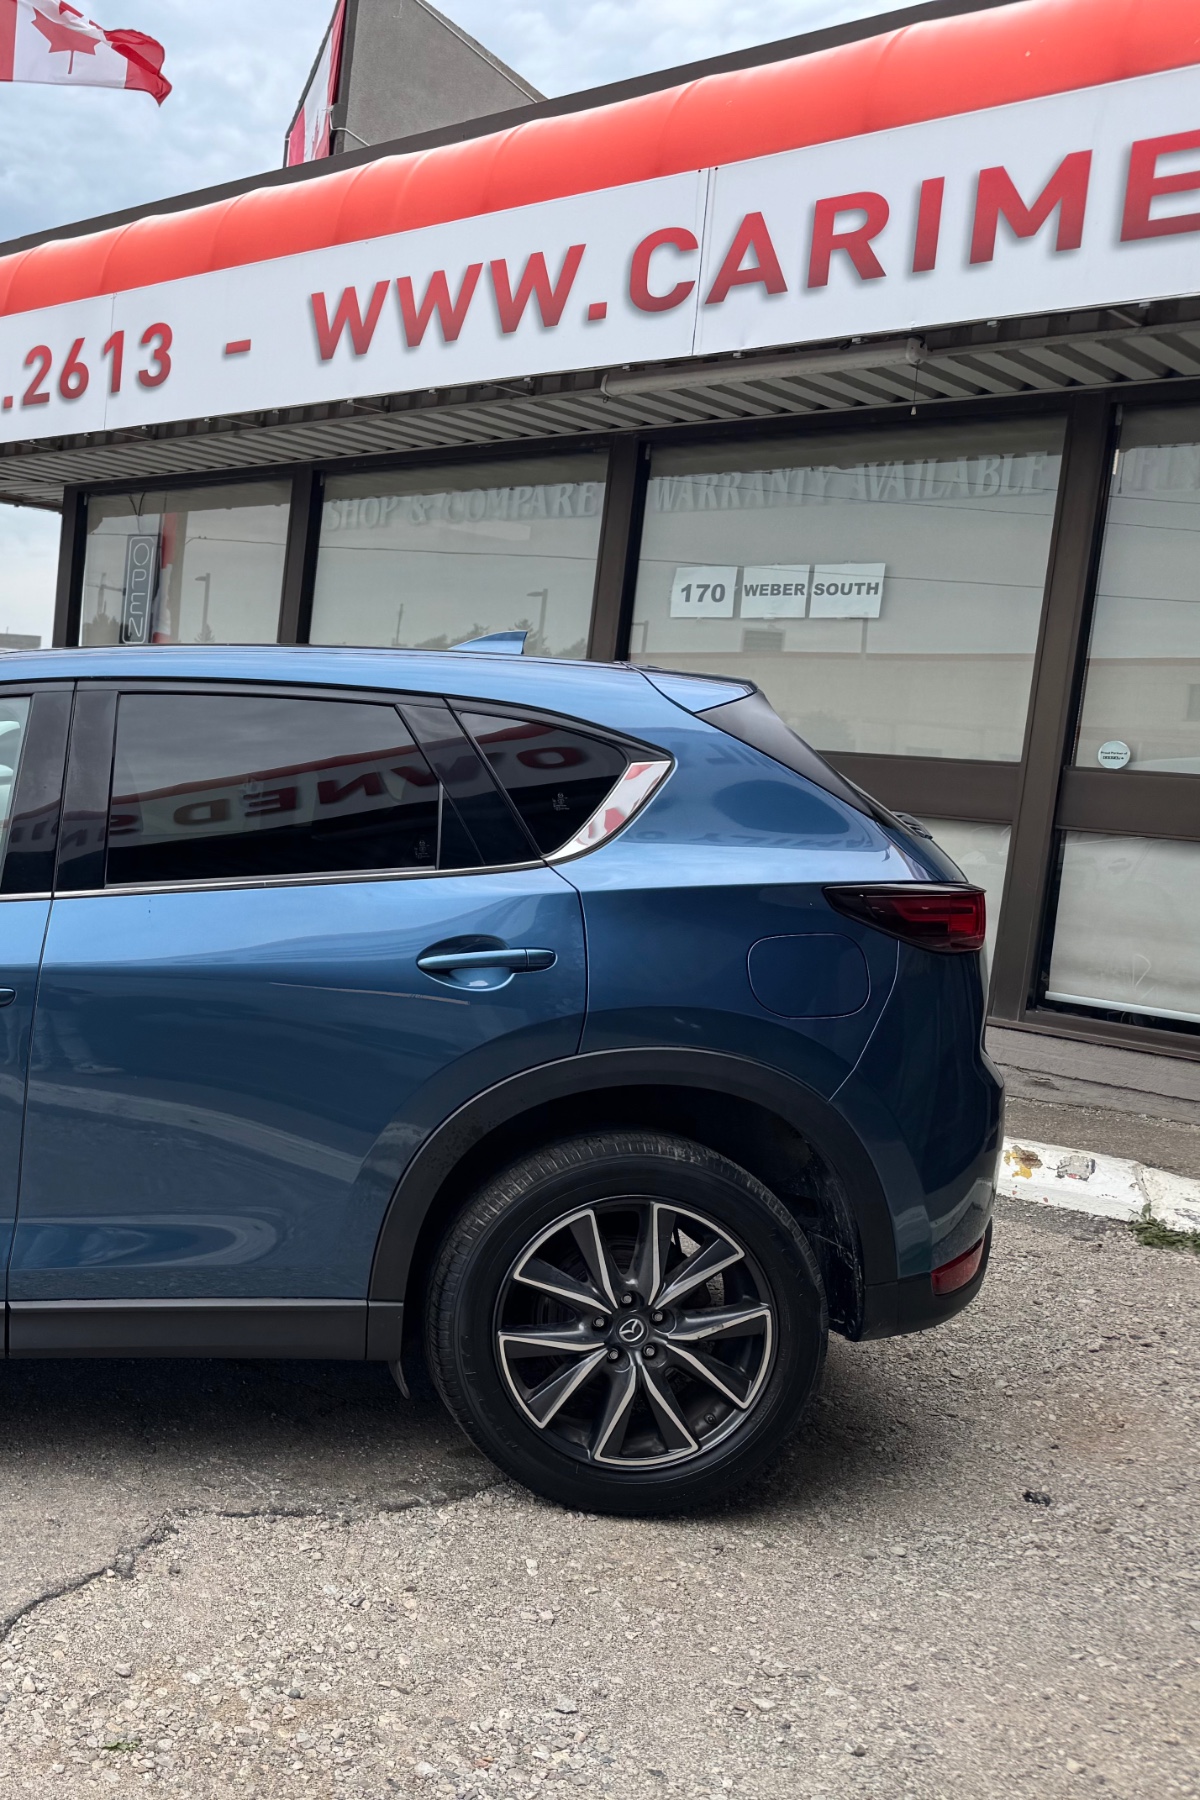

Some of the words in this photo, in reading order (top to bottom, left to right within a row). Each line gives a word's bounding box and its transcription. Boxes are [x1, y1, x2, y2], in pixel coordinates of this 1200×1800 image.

[324, 496, 399, 532] SHOP
[445, 482, 599, 523] COMPARE
[653, 465, 838, 512] WARRANTY
[850, 451, 1049, 502] AVAILABLE
[127, 542, 151, 638] OPEN
[679, 582, 726, 603] 170
[743, 582, 806, 598] WEBER
[812, 581, 880, 597] SOUTH
